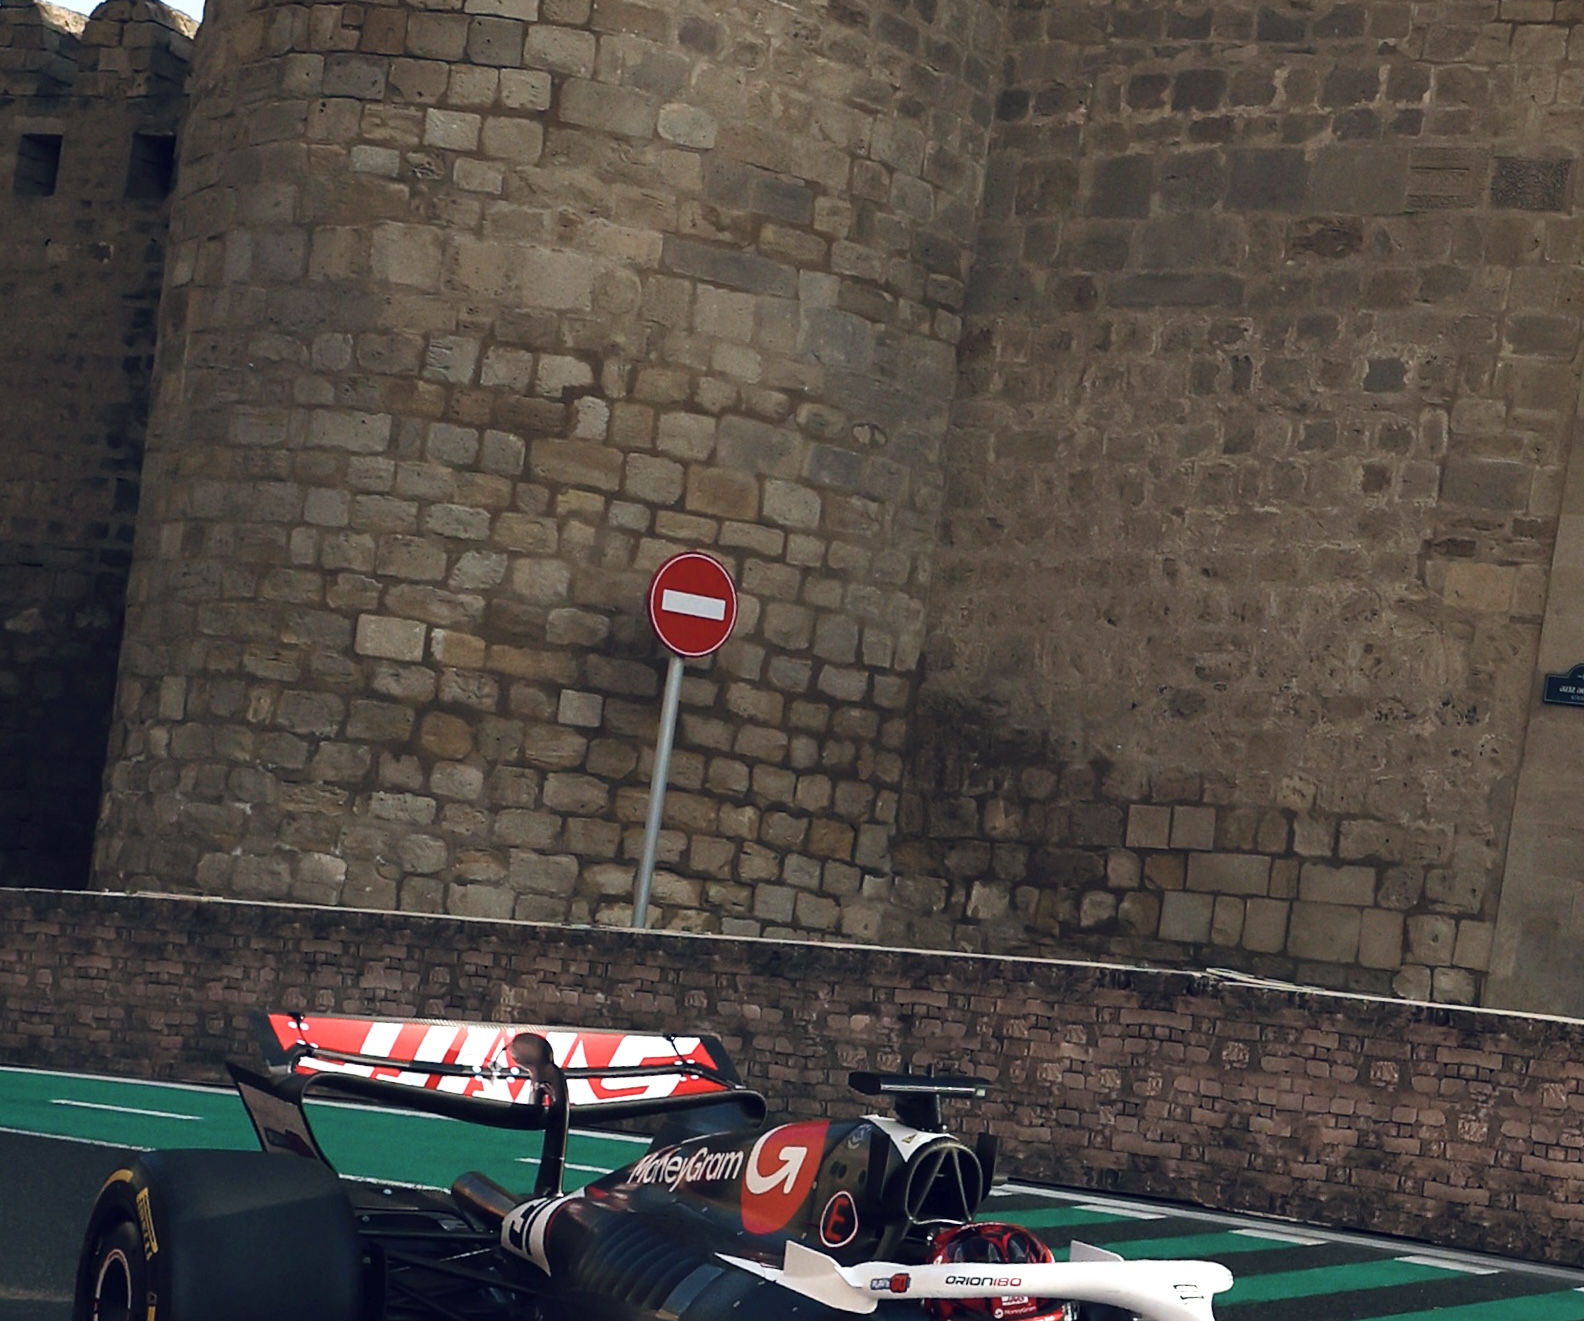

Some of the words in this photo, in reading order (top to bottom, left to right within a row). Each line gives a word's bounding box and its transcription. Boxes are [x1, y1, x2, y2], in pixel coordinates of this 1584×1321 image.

[627, 1147, 744, 1192] MoneyGram
[826, 1197, 849, 1242] E
[945, 1275, 1022, 1287] ORION180
